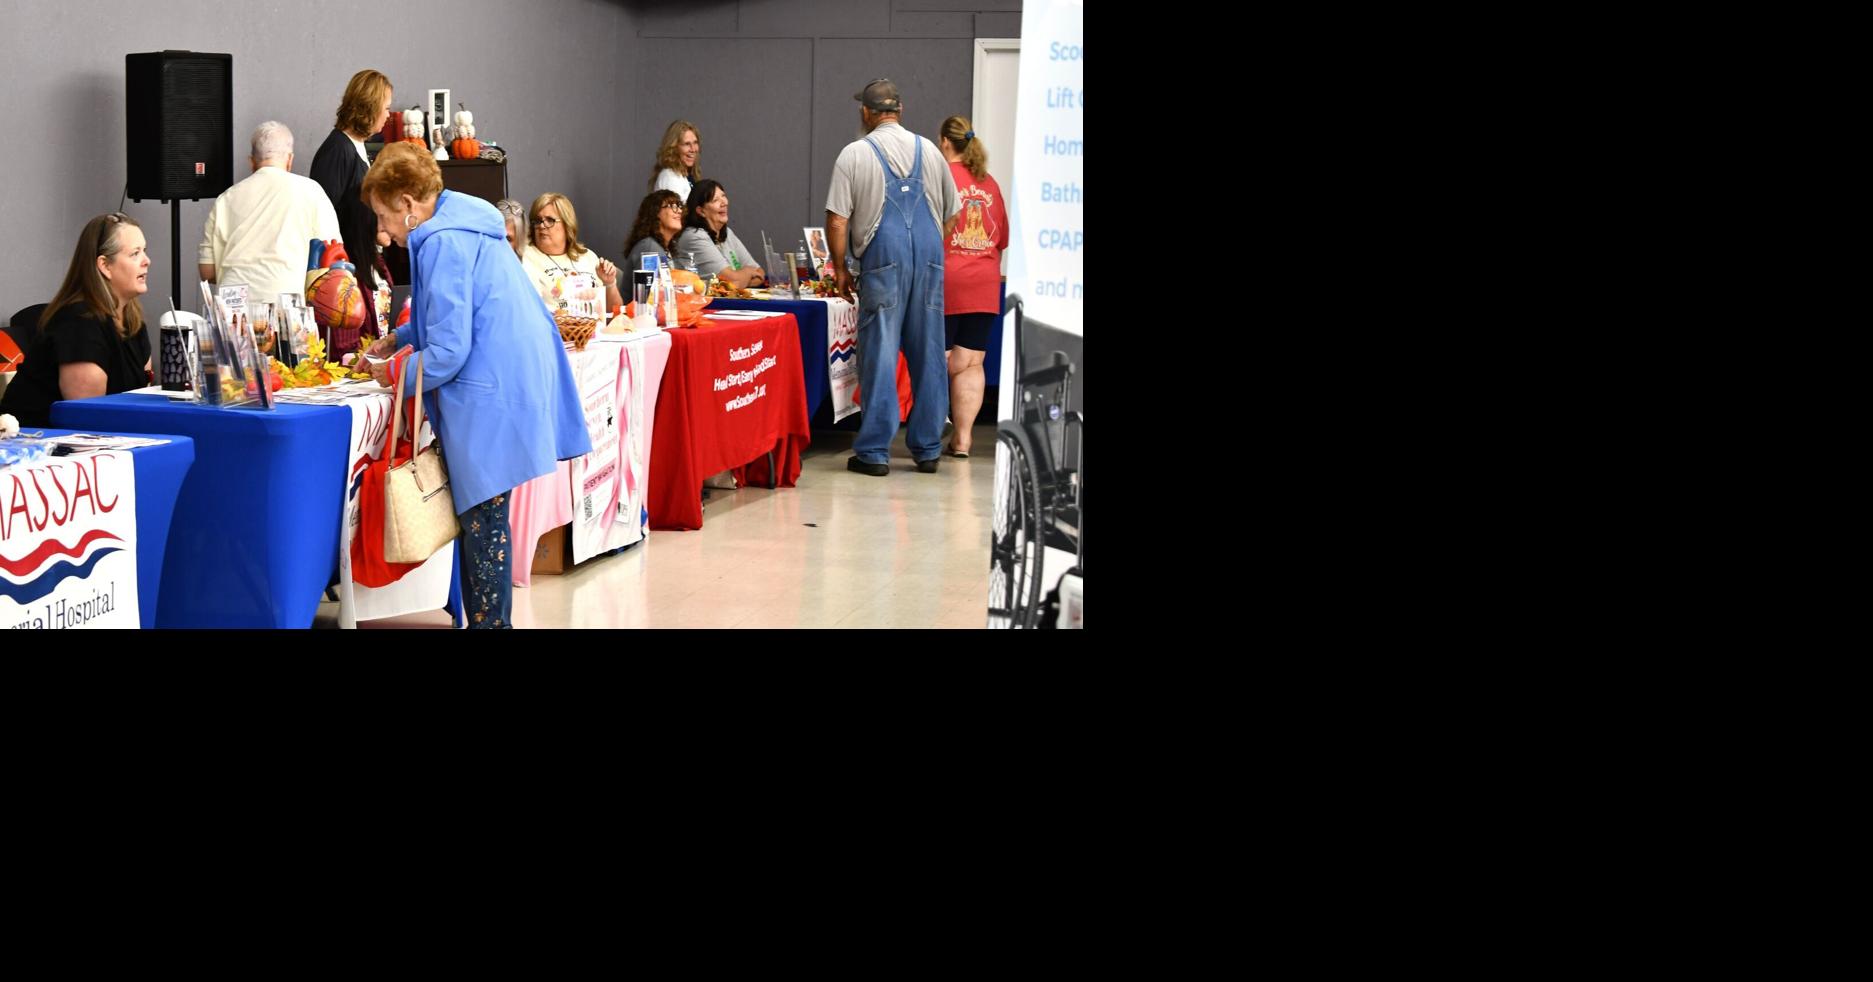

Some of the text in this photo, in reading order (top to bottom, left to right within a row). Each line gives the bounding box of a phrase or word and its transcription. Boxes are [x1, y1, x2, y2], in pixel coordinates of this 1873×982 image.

[1047, 86, 1074, 108] Lift
[1041, 181, 1083, 203] Bath
[1038, 229, 1083, 252] CPAP
[1035, 277, 1067, 298] and
[56, 581, 115, 630] Hospital
